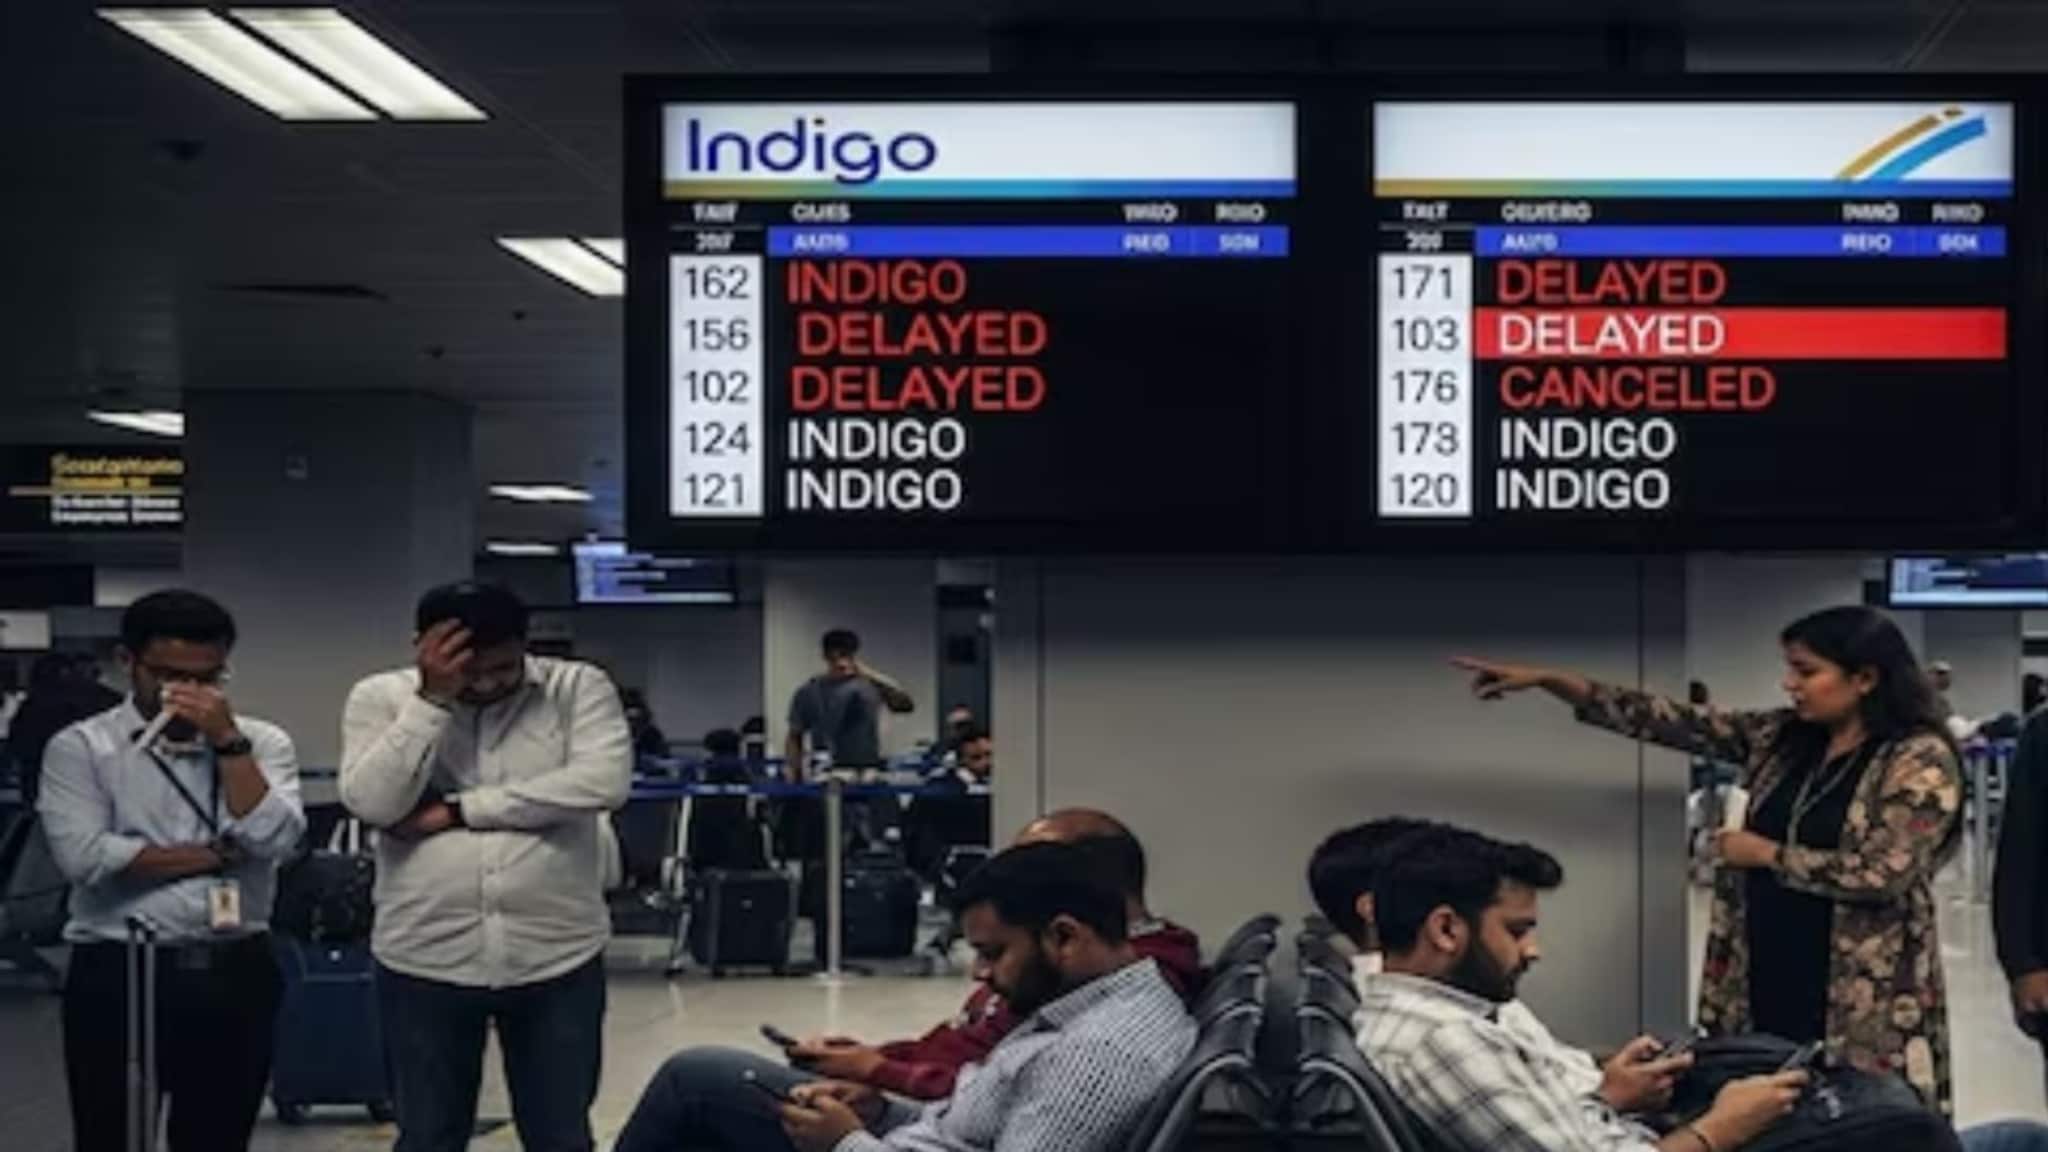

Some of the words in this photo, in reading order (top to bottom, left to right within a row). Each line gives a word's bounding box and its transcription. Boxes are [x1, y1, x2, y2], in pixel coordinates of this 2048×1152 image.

[687, 117, 938, 184] Indigo
[685, 266, 749, 297] 162
[788, 261, 966, 303] INDIGO
[1394, 266, 1452, 299] 171
[1497, 260, 1726, 304] DELAYED
[686, 318, 750, 351] 156
[799, 312, 1047, 356] DELAYED
[1394, 318, 1459, 351] 103
[1499, 314, 1725, 355] DELAYED
[686, 370, 749, 403] 102
[791, 366, 1046, 410] DELAYED
[1394, 370, 1458, 403] 176
[1500, 366, 1776, 410] CANCELED
[686, 421, 751, 455] 124
[788, 418, 966, 461] INDIGO
[1500, 418, 1677, 461] INDIGO
[686, 473, 744, 506] 121
[786, 469, 962, 510] INDIGO
[1393, 473, 1459, 507] 120
[1496, 469, 1670, 510] INDIGO
